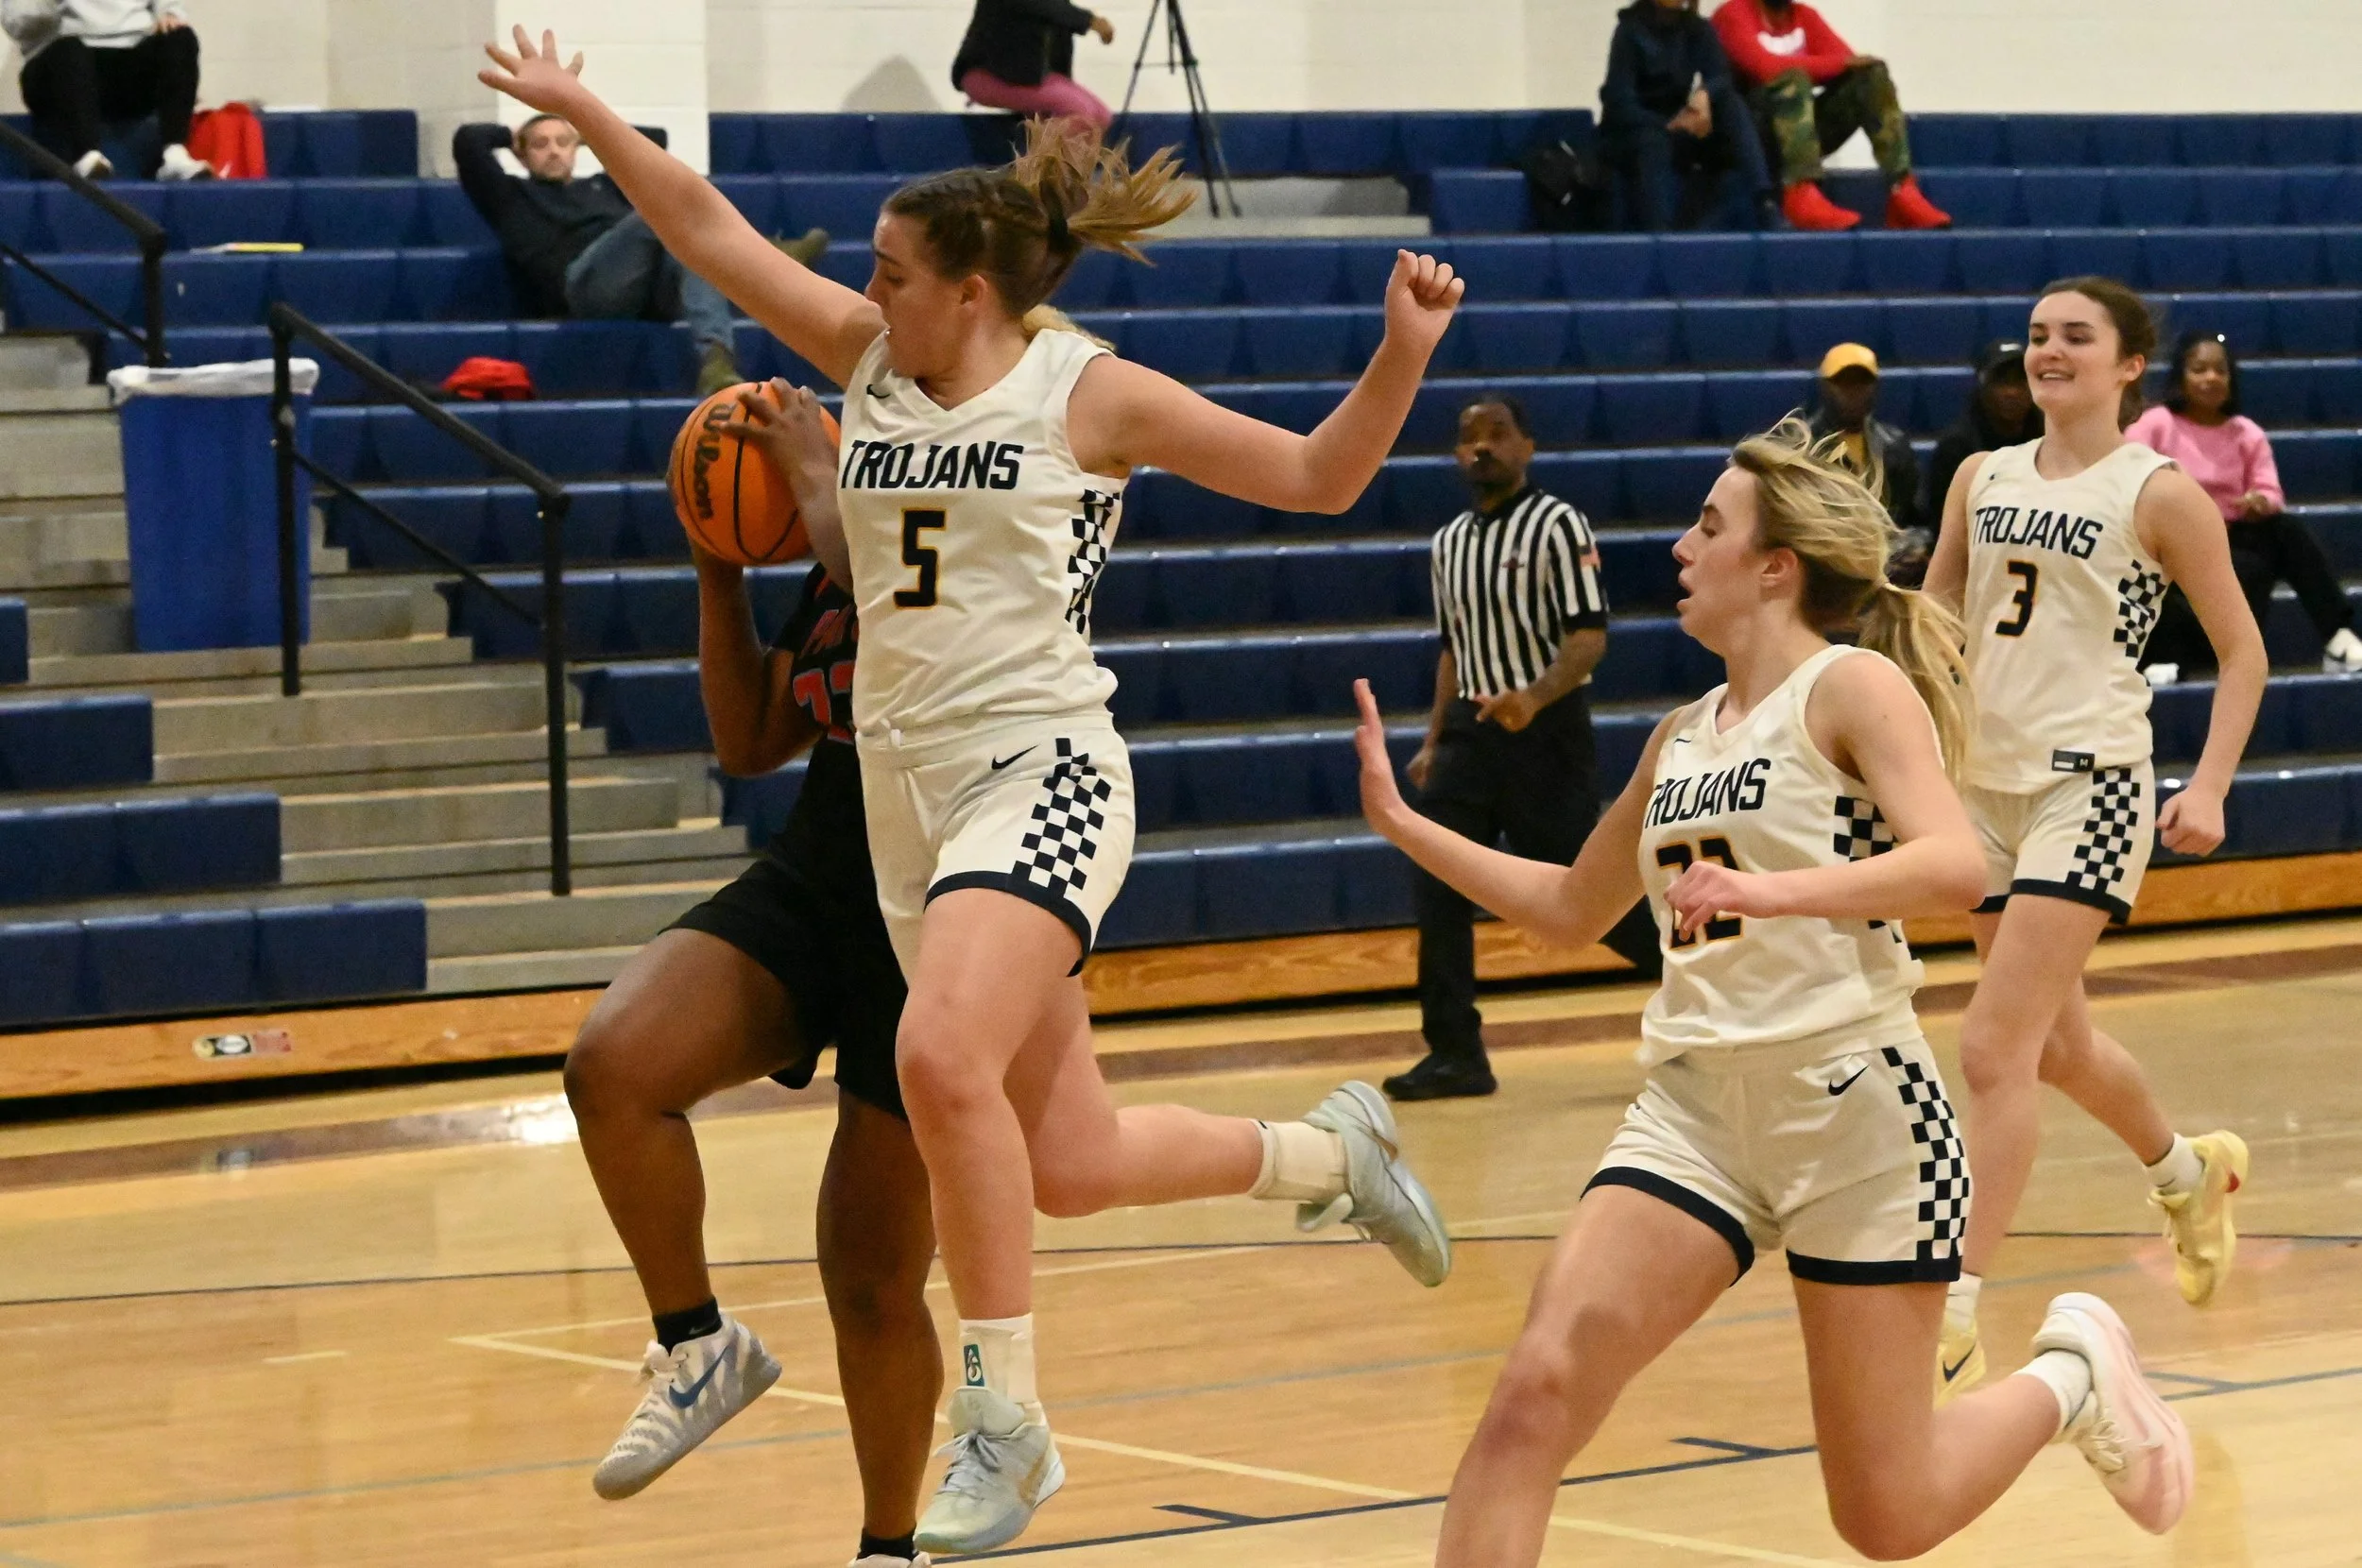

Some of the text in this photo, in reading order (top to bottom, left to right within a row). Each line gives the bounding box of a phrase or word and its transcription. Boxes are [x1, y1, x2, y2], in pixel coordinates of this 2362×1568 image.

[841, 439, 1024, 490] TROJANS
[893, 507, 947, 610] 5
[1973, 505, 2104, 560] TROJANS
[1994, 559, 2039, 638] 3
[1645, 758, 1772, 828] ROJANS
